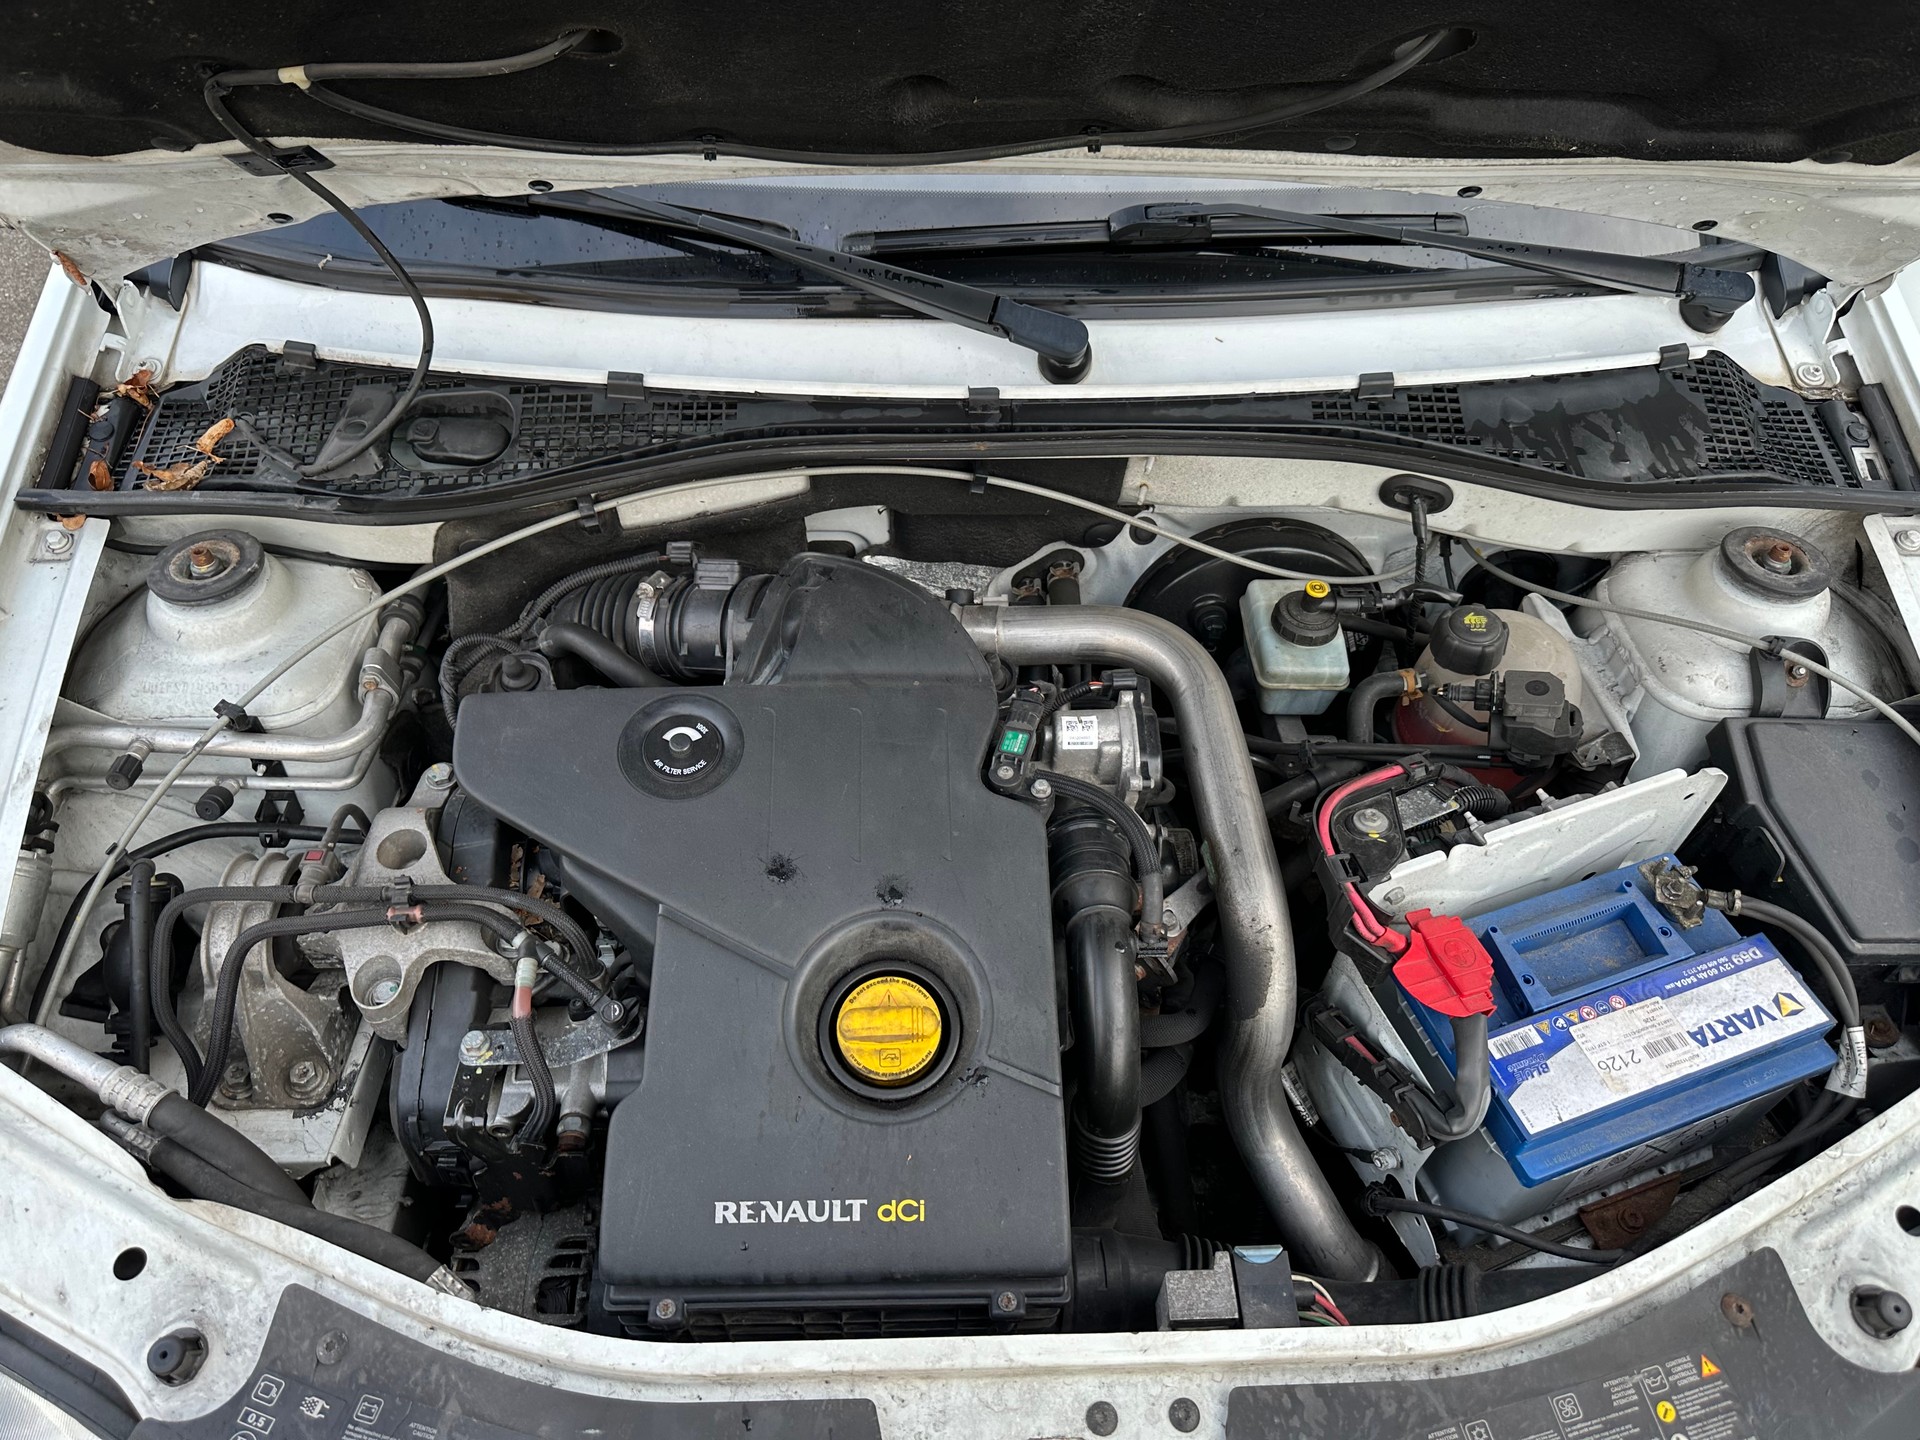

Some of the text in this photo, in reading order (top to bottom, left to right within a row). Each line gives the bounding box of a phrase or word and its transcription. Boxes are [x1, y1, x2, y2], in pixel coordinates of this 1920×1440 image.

[653, 759, 707, 775] AIR FILTER SERVICE
[1730, 946, 1763, 966] D59
[1720, 962, 1735, 973] 12V
[866, 979, 888, 989] exceed
[901, 980, 917, 989] maxi
[916, 987, 929, 1000] level
[1687, 1003, 1778, 1050] VARTA
[1507, 1052, 1545, 1073] Dynamic
[1597, 1049, 1641, 1075] 2126
[1514, 1063, 1550, 1084] BLUE
[714, 1199, 926, 1224] RENAULT dCi
[1668, 1368, 1697, 1381] KONTROLLE
[1671, 1362, 1694, 1373] CONTROL
[1676, 1374, 1700, 1386] CONTROL
[1611, 1388, 1636, 1400] ACHTUNG
[247, 1413, 267, 1427] 0,5
[409, 1422, 438, 1434] ATTENTION
[412, 1430, 436, 1440] CAUTION
[1428, 1427, 1457, 1440] ATTENTION
